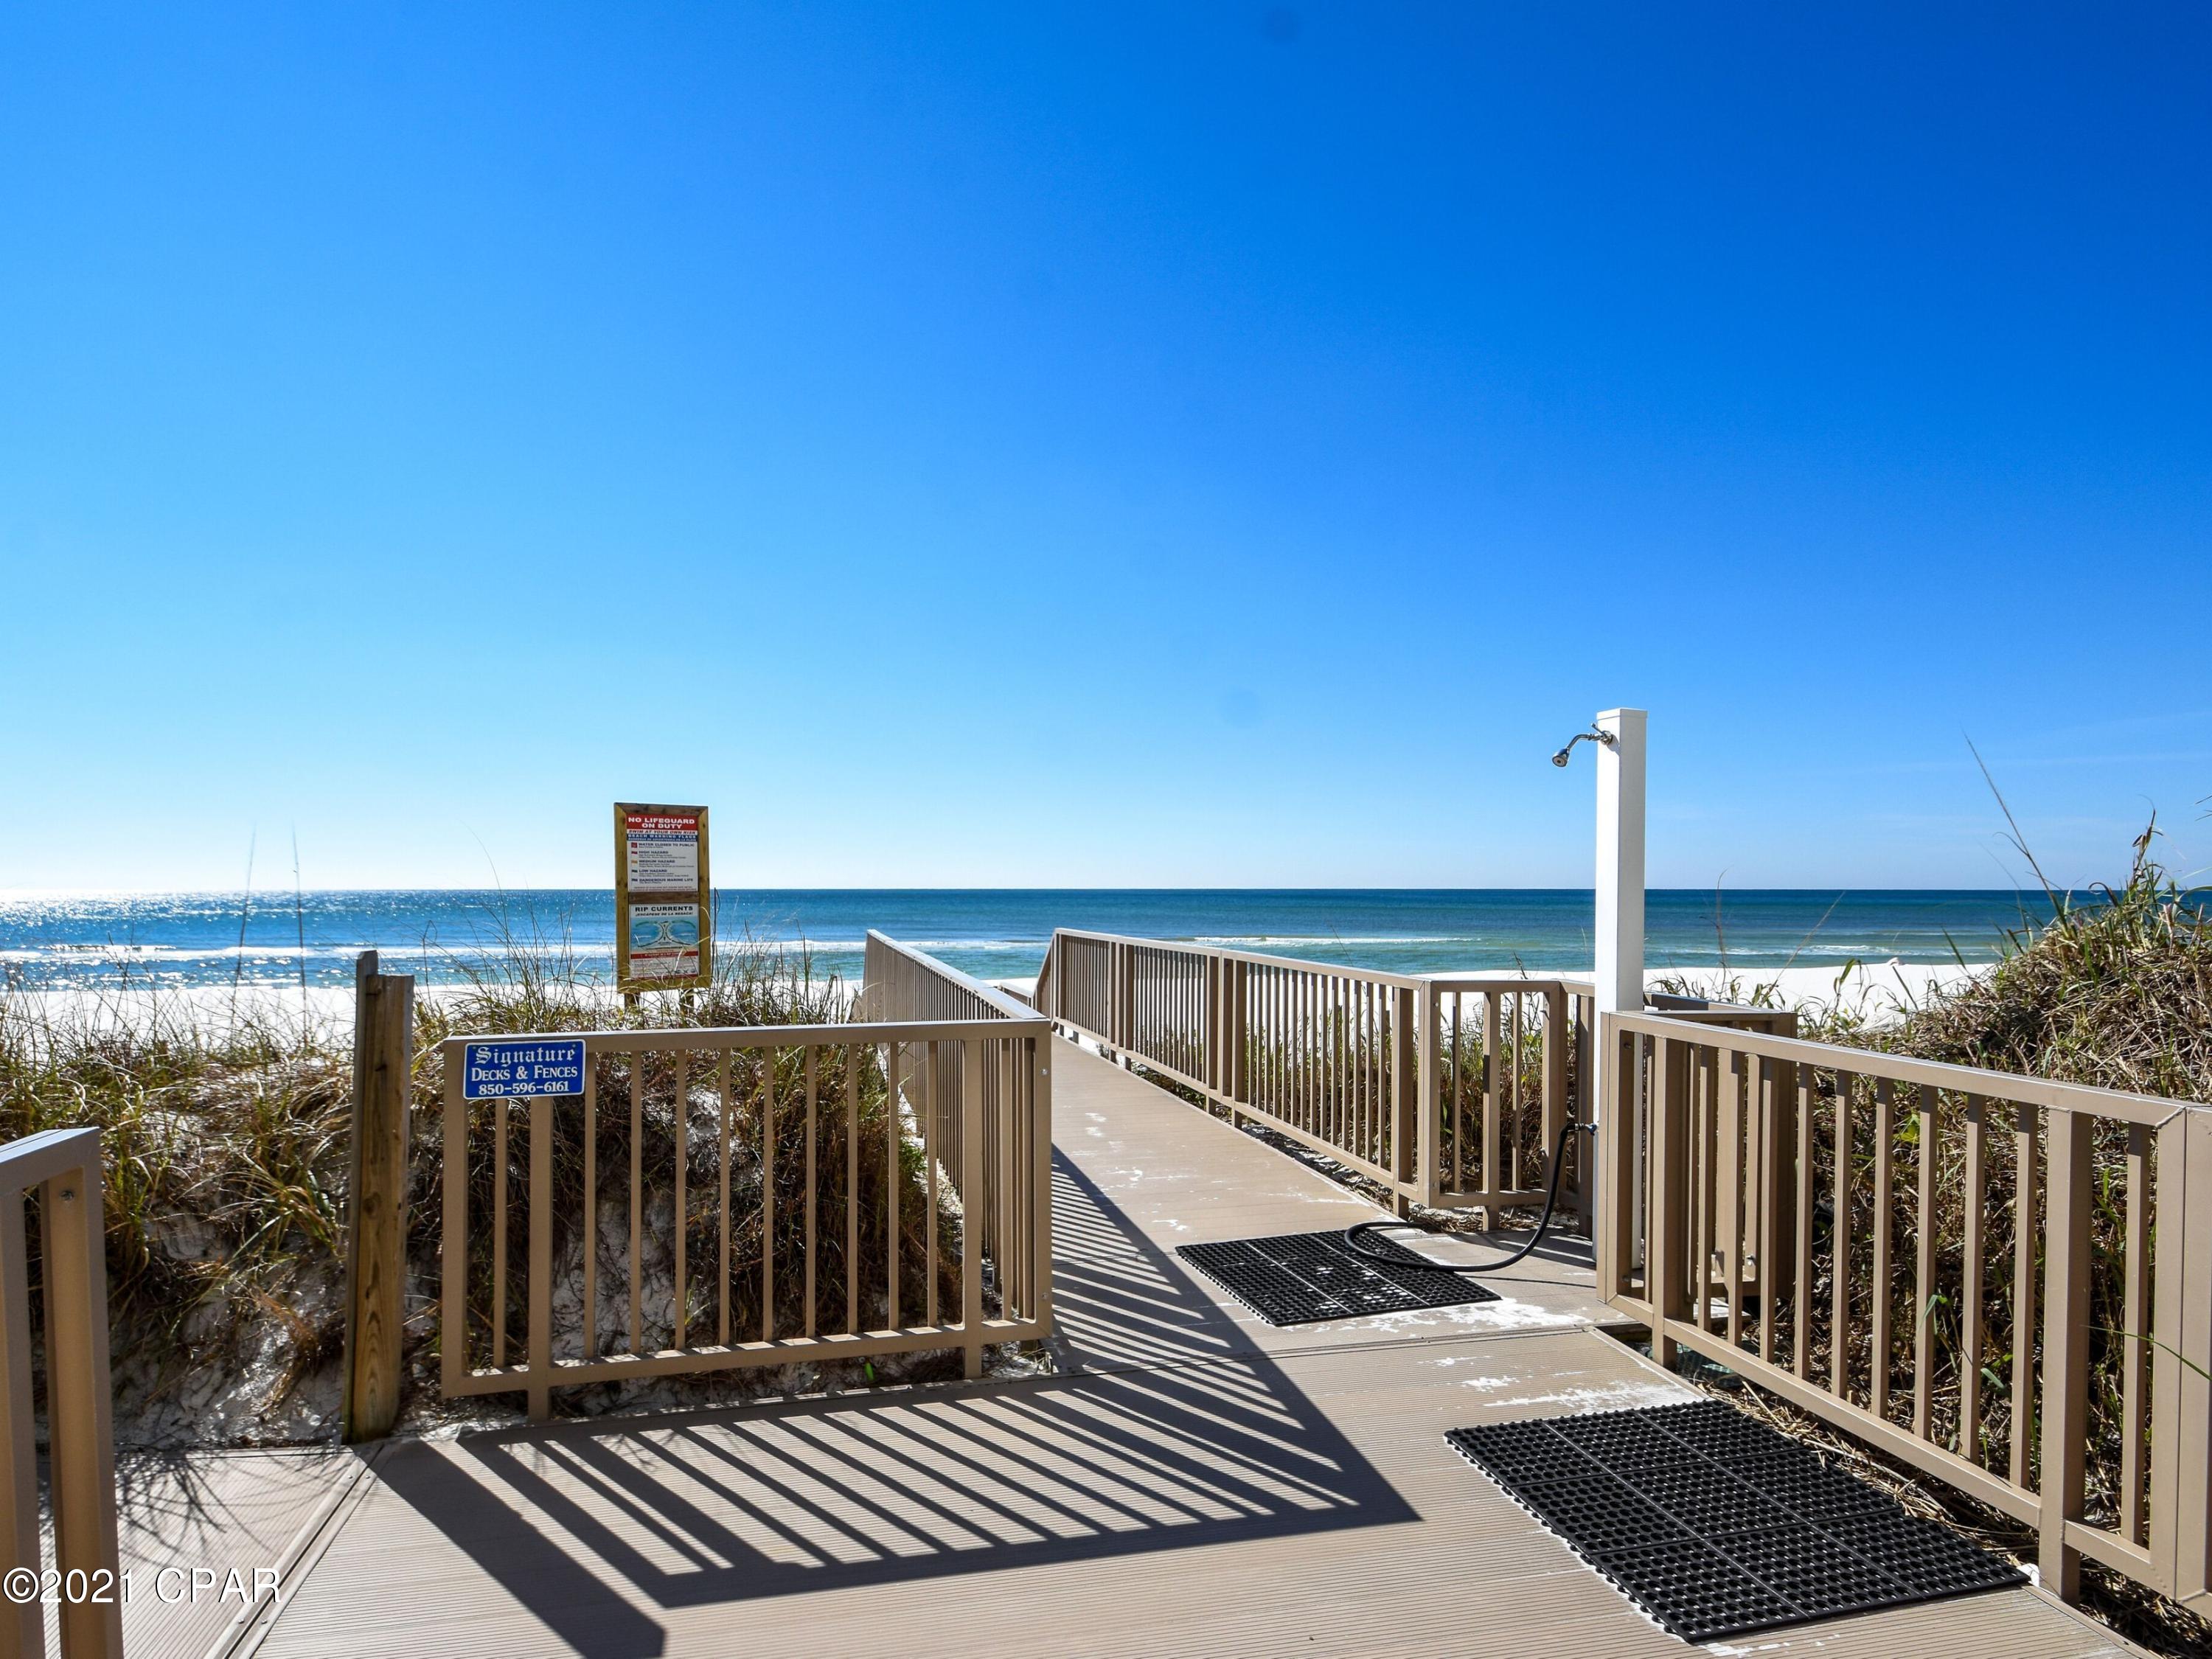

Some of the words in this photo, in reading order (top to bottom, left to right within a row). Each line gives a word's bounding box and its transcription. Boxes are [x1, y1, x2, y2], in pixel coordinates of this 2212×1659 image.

[475, 1046, 575, 1067] Signature
[471, 1068, 510, 1081] DECKS
[516, 1066, 528, 1080] &
[534, 1065, 578, 1078] FENCES
[479, 1081, 569, 1095] 850-596-6161
